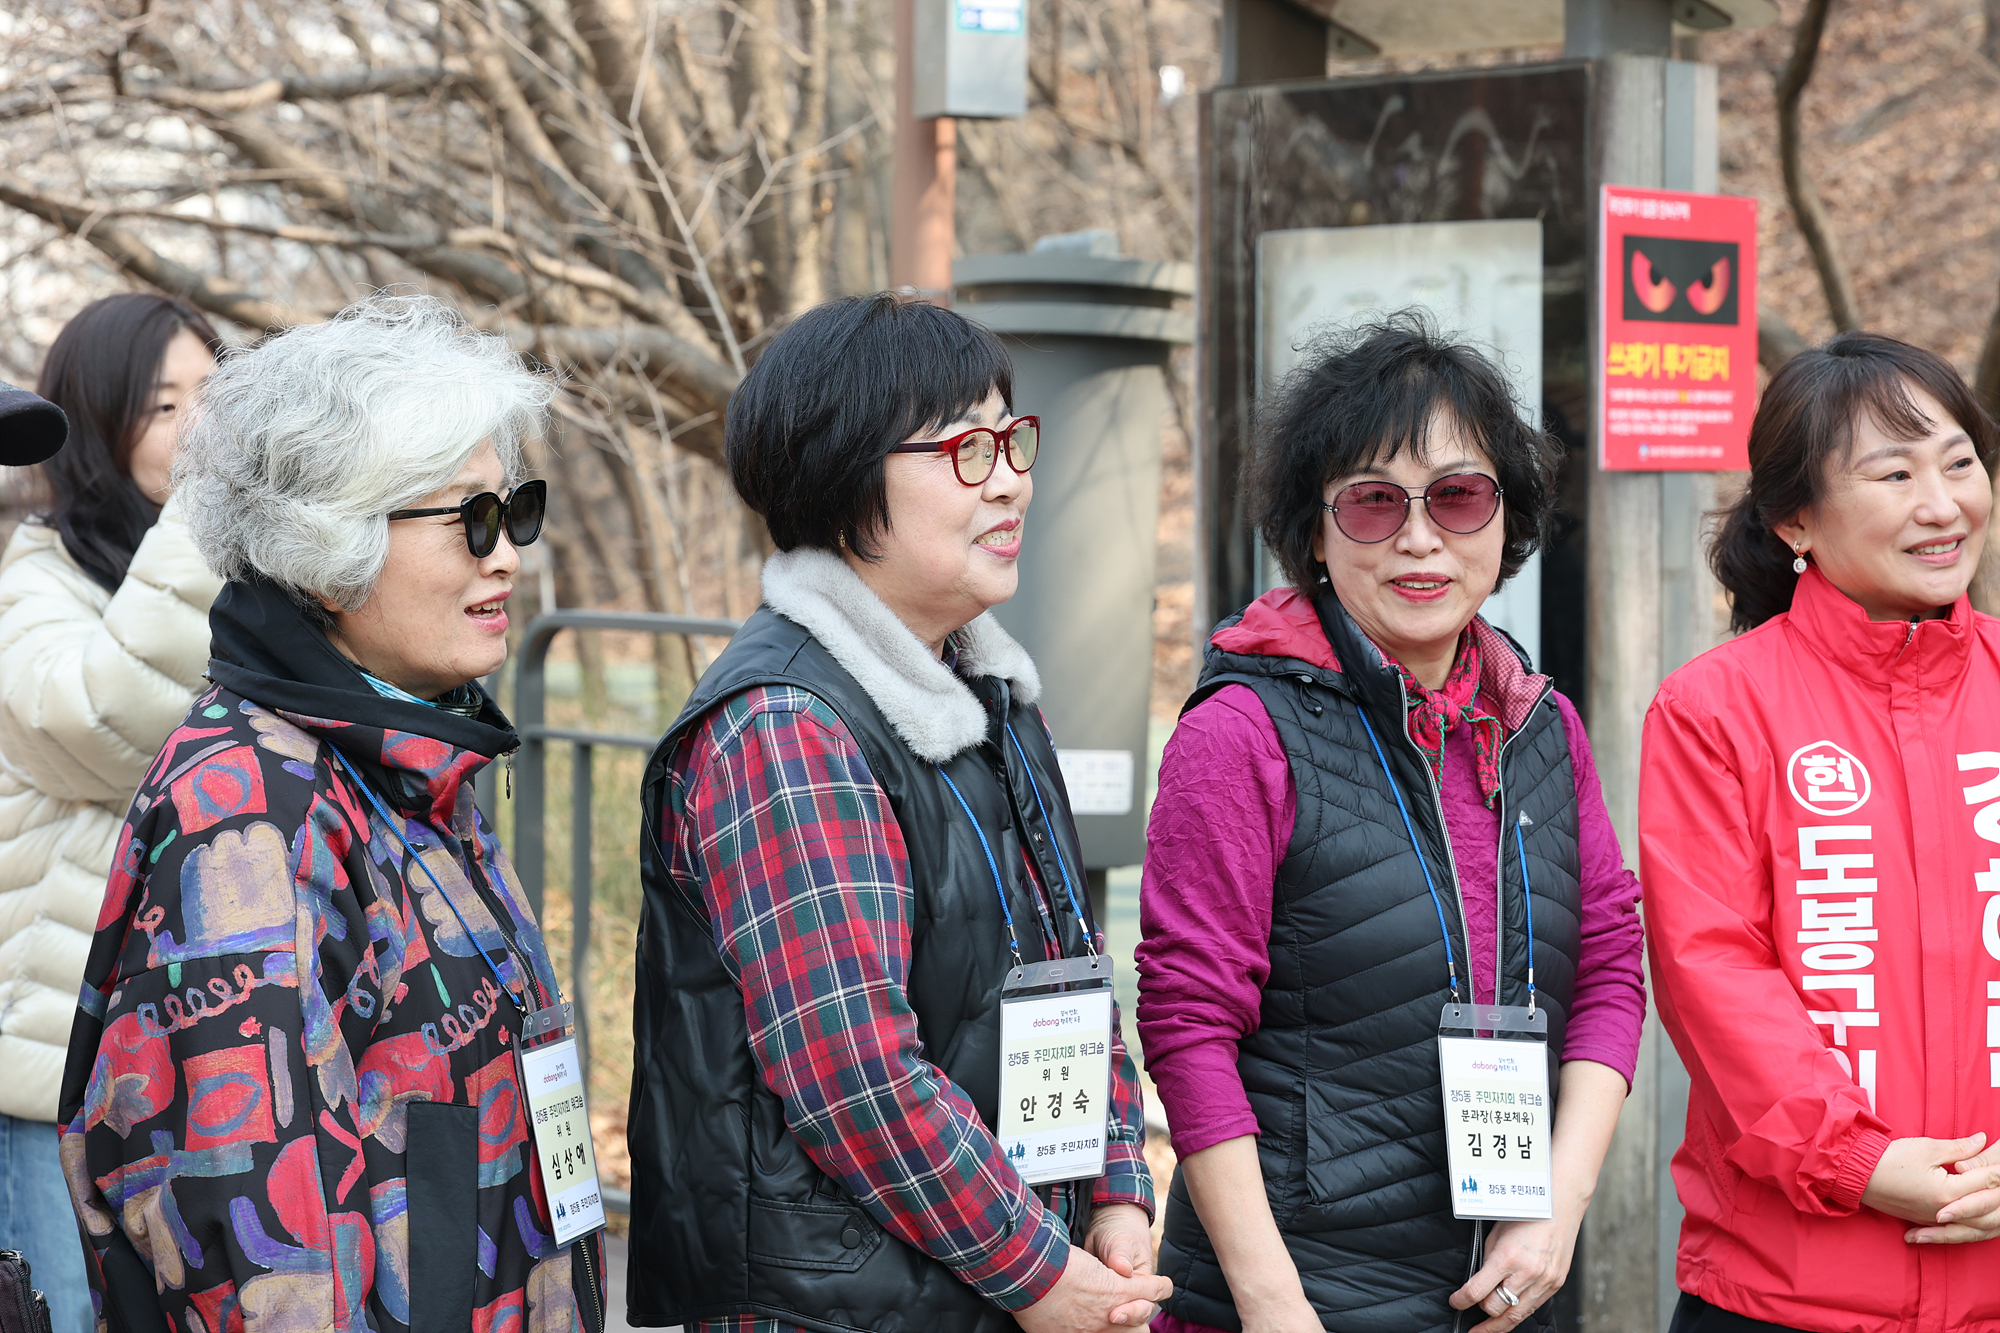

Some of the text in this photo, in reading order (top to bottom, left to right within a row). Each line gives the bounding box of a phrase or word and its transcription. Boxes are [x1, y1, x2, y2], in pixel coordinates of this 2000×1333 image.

[1607, 342, 1730, 381] 쓰레기 투기금지
[1800, 754, 1858, 802] 현
[1033, 1018, 1059, 1027] dobong
[1008, 1042, 1104, 1066] 창5동 주민자치회 워크숍
[1472, 1061, 1498, 1072] dobong
[1450, 1090, 1542, 1106] 창5동 주민자치회 워크숍
[1461, 1109, 1534, 1126] 분과장(홍보체육)
[1036, 1138, 1099, 1157] 창5동 주민자치회
[1488, 1184, 1545, 1196] 창5동 주민자치회
